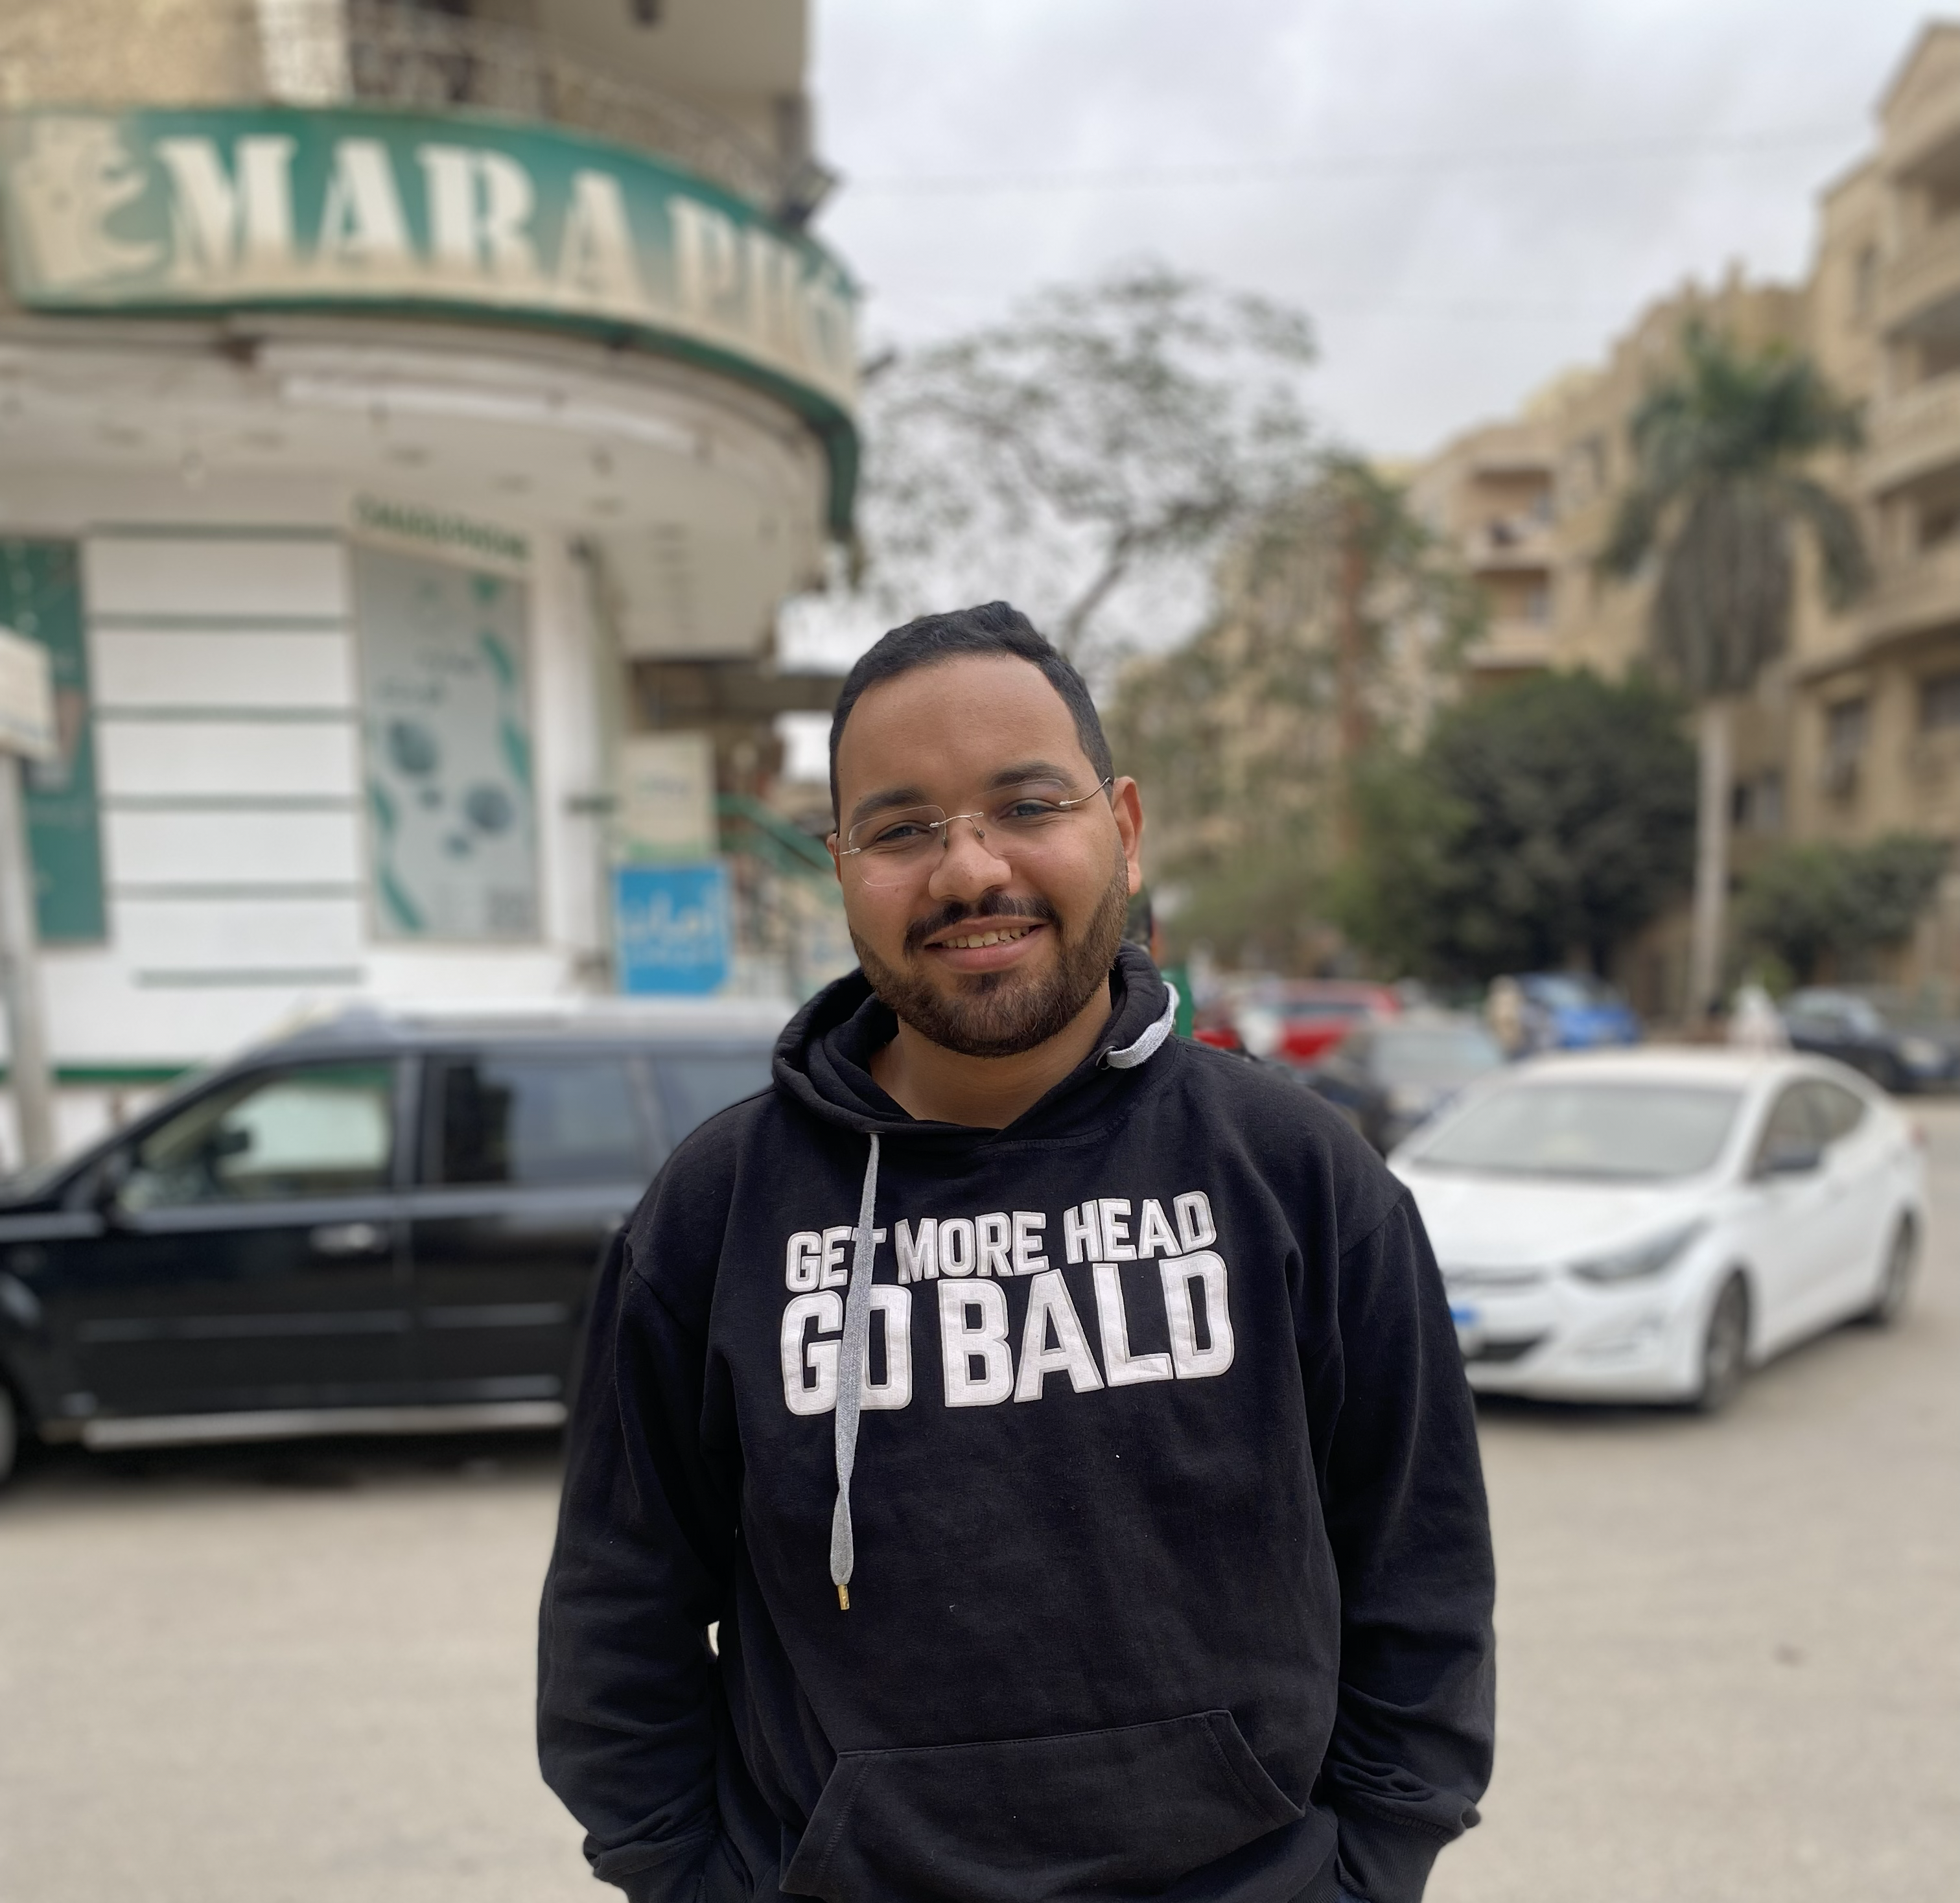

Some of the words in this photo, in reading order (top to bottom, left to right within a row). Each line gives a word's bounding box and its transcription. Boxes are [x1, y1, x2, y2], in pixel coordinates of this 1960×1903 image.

[785, 1225, 887, 1292] GE
[894, 1211, 1049, 1284] MORE
[1063, 1191, 1217, 1265] HEAD
[780, 1283, 913, 1416] GO
[937, 1250, 1235, 1408] BALD
